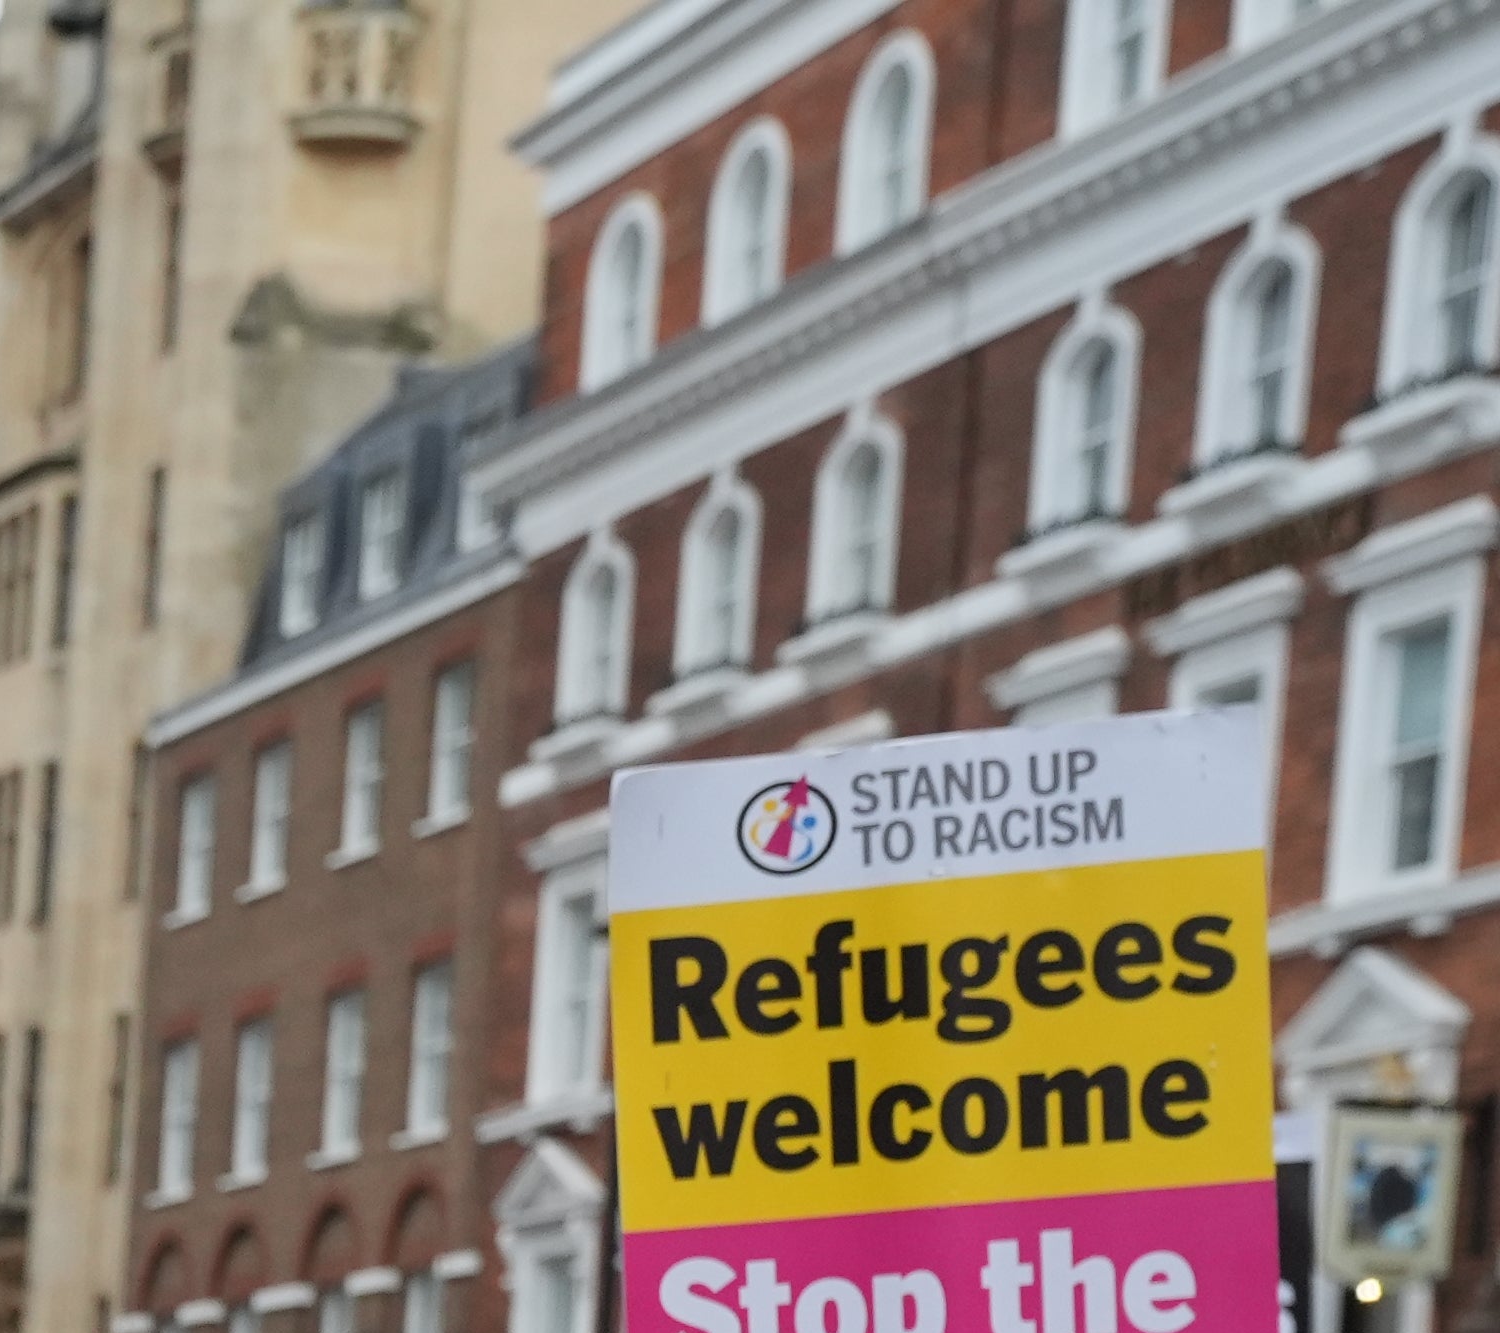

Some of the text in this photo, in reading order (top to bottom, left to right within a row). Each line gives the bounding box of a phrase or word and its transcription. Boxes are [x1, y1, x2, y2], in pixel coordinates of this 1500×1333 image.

[851, 749, 1098, 815] STAND UP
[851, 796, 1125, 867] TO RACISM
[649, 912, 1237, 1046] Refugees
[652, 1055, 1212, 1180] welcome
